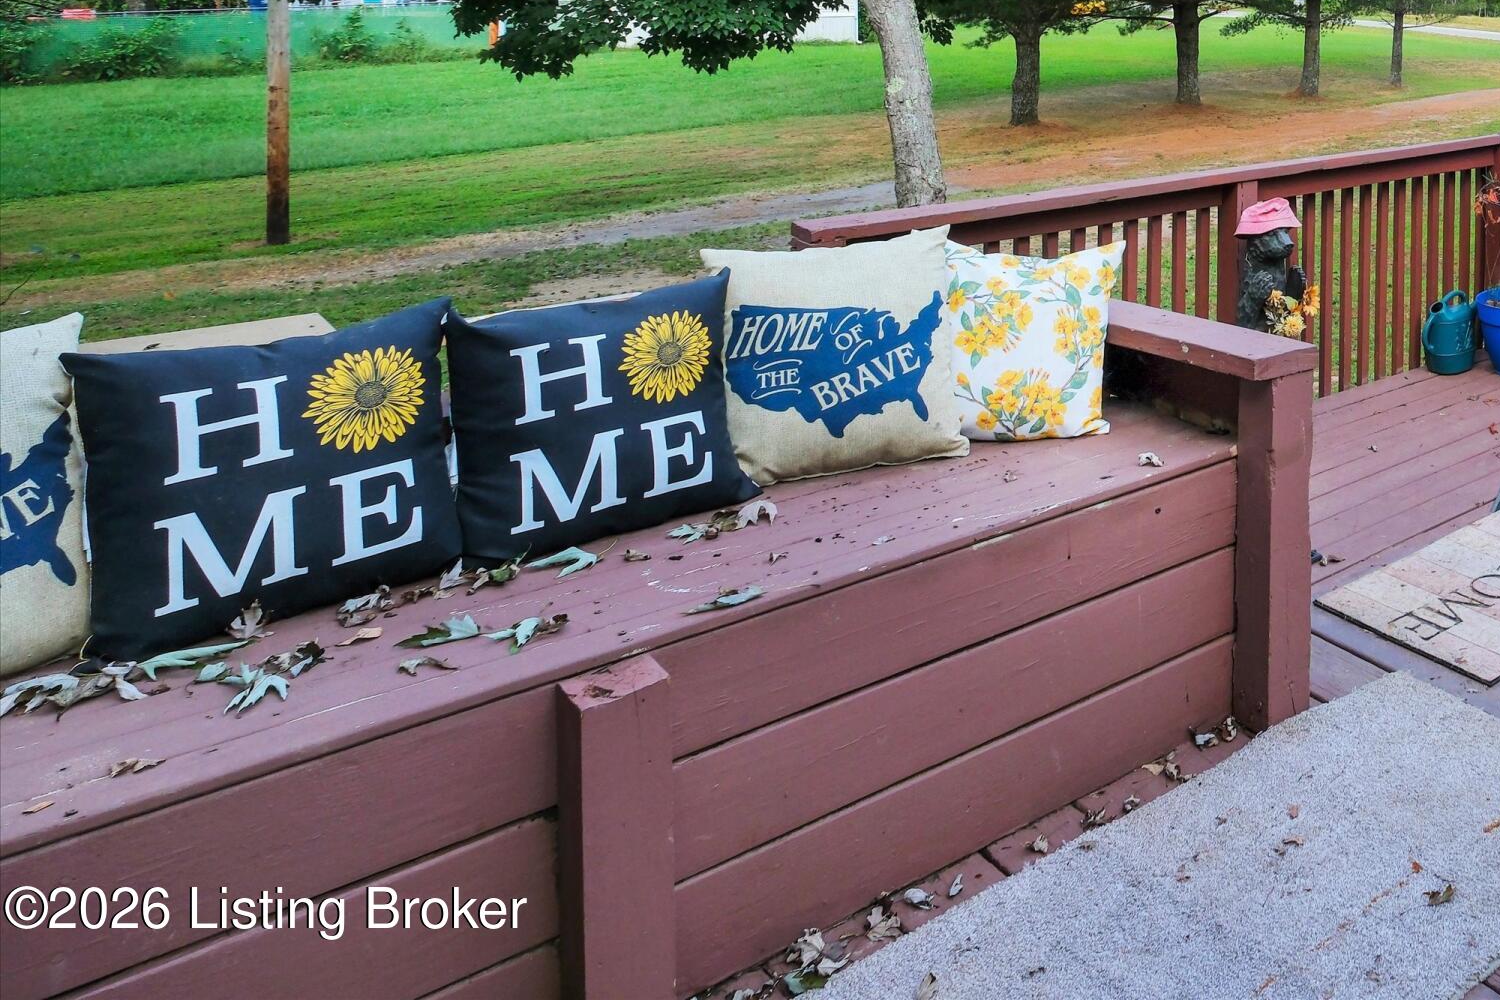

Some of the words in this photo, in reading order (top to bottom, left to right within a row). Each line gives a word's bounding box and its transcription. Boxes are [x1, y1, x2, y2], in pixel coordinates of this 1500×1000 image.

[729, 312, 829, 360] HOME
[834, 324, 864, 352] OF
[757, 367, 800, 389] THE
[811, 342, 921, 411] BRAVE
